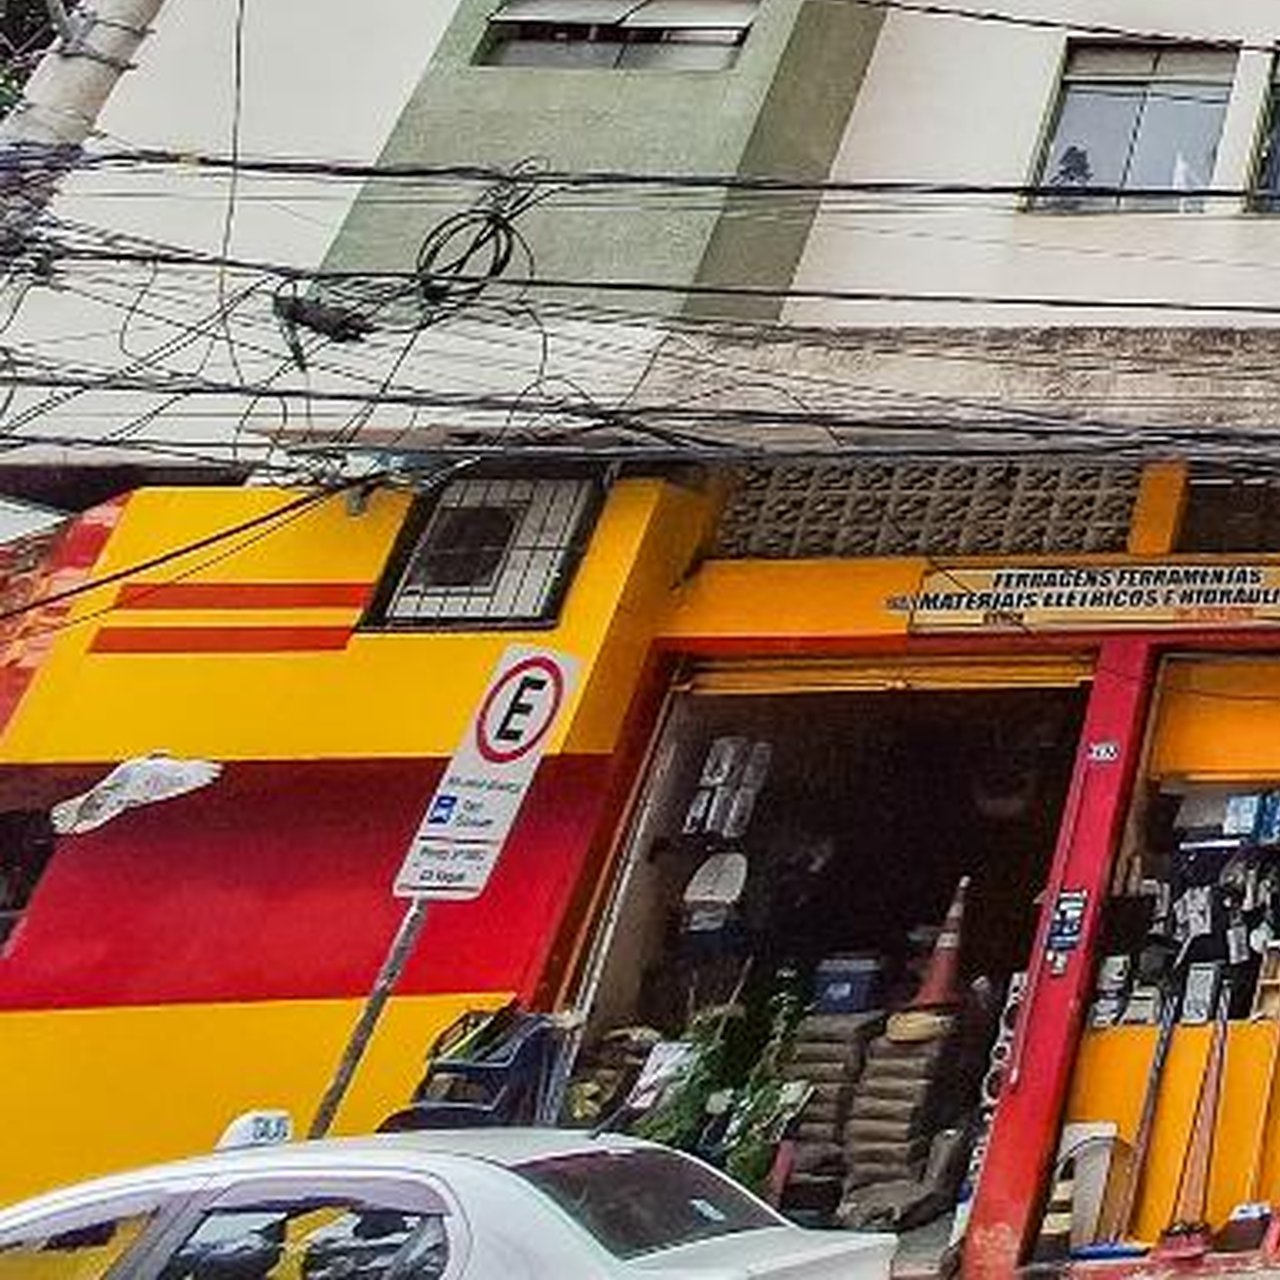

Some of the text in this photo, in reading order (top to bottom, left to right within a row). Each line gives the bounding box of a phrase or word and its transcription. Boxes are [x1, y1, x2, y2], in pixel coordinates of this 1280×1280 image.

[992, 568, 1262, 589] FERRAGENS FERRAMENTAS
[918, 591, 1038, 611] MATERIAIS
[494, 675, 548, 742] E
